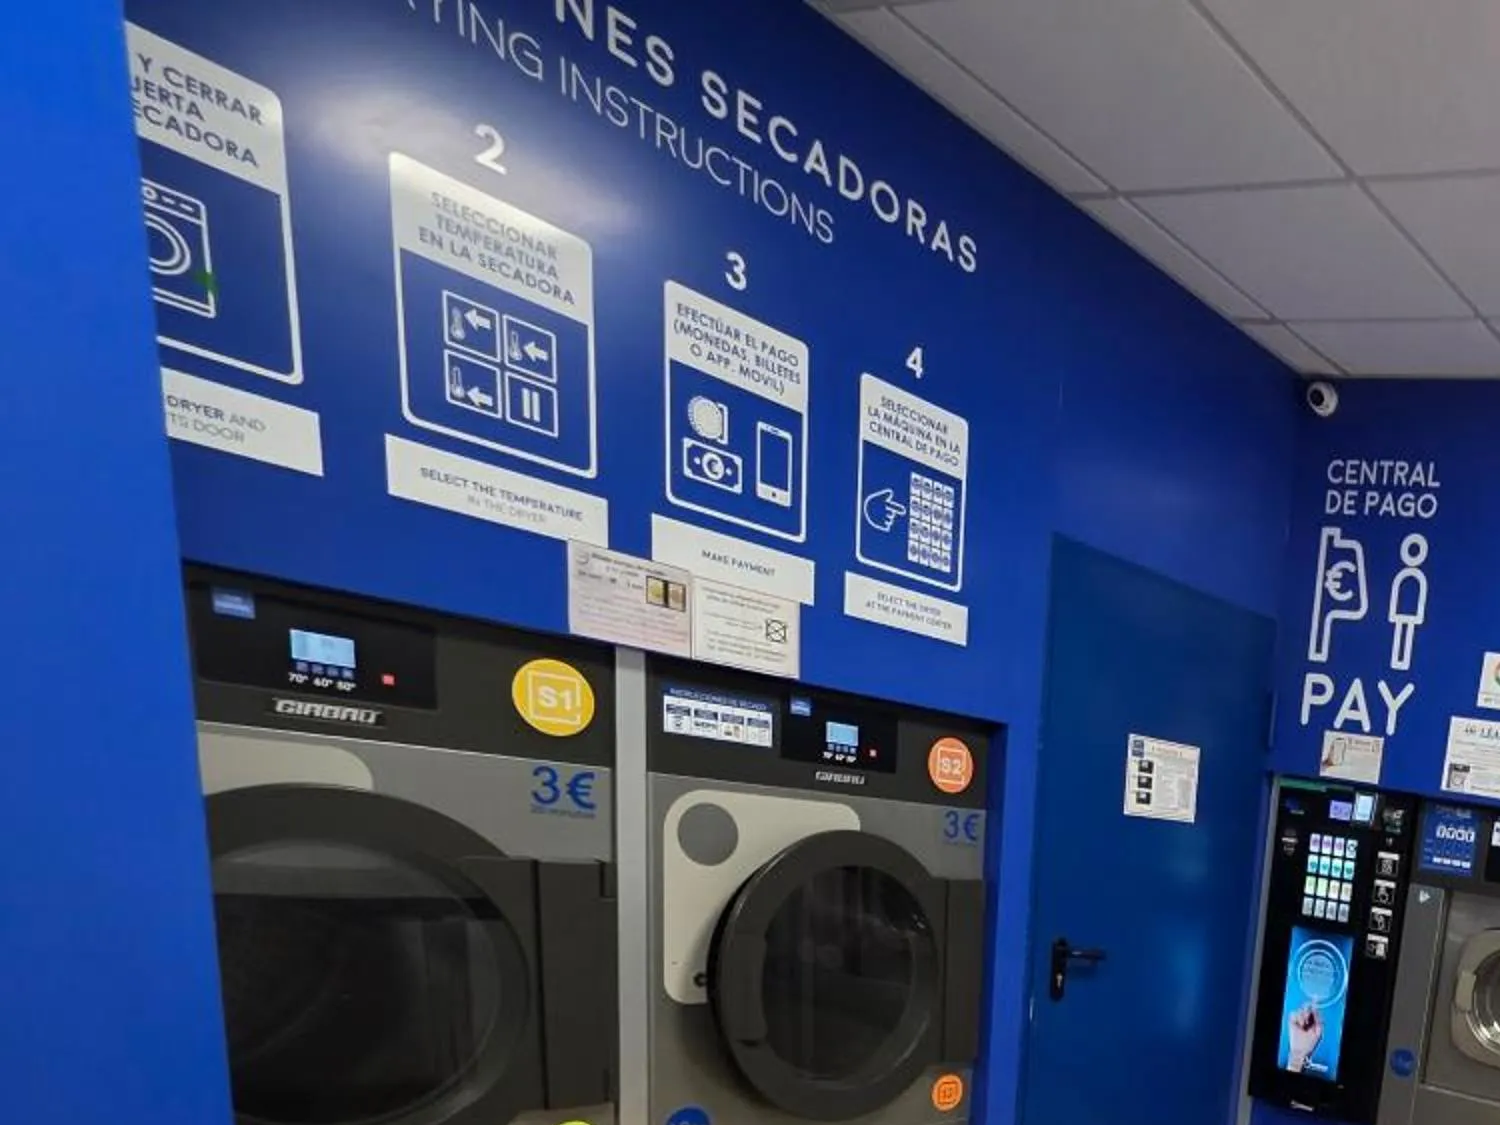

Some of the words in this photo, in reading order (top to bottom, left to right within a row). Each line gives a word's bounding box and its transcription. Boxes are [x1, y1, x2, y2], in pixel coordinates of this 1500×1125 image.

[137, 52, 153, 73] Y
[162, 65, 263, 126] CERRAR
[473, 123, 508, 176] 2
[559, 56, 834, 245] INSTRUCTIONS
[701, 70, 978, 274] SECADORAS
[431, 191, 559, 261] SELECCIONAR
[417, 225, 444, 251] EN
[449, 241, 473, 262] LA
[477, 251, 577, 306] SECADORA
[435, 213, 560, 281] TEMPERATURA
[724, 250, 748, 291] 3
[689, 342, 703, 357] O
[744, 333, 758, 351] EL
[760, 340, 799, 368] PAGO
[755, 355, 801, 385] BILLETES
[905, 346, 924, 380] 4
[166, 394, 226, 422] DRYER
[229, 412, 268, 434] AND
[867, 405, 881, 420] LA
[934, 434, 948, 450] EN
[880, 394, 949, 435] SELECCIONAR
[869, 420, 913, 449] CENTRAL
[915, 439, 928, 453] DE
[1326, 458, 1441, 488] CENTRAL
[419, 466, 470, 490] SELECT
[472, 480, 496, 498] THE
[499, 487, 585, 522] TEMPERATURE
[1324, 489, 1357, 515] DE
[1363, 491, 1438, 519] PAGO
[731, 557, 777, 578] PAYMENT
[537, 685, 573, 712] S1
[1301, 672, 1415, 736] PAY
[531, 764, 597, 811] 3€
